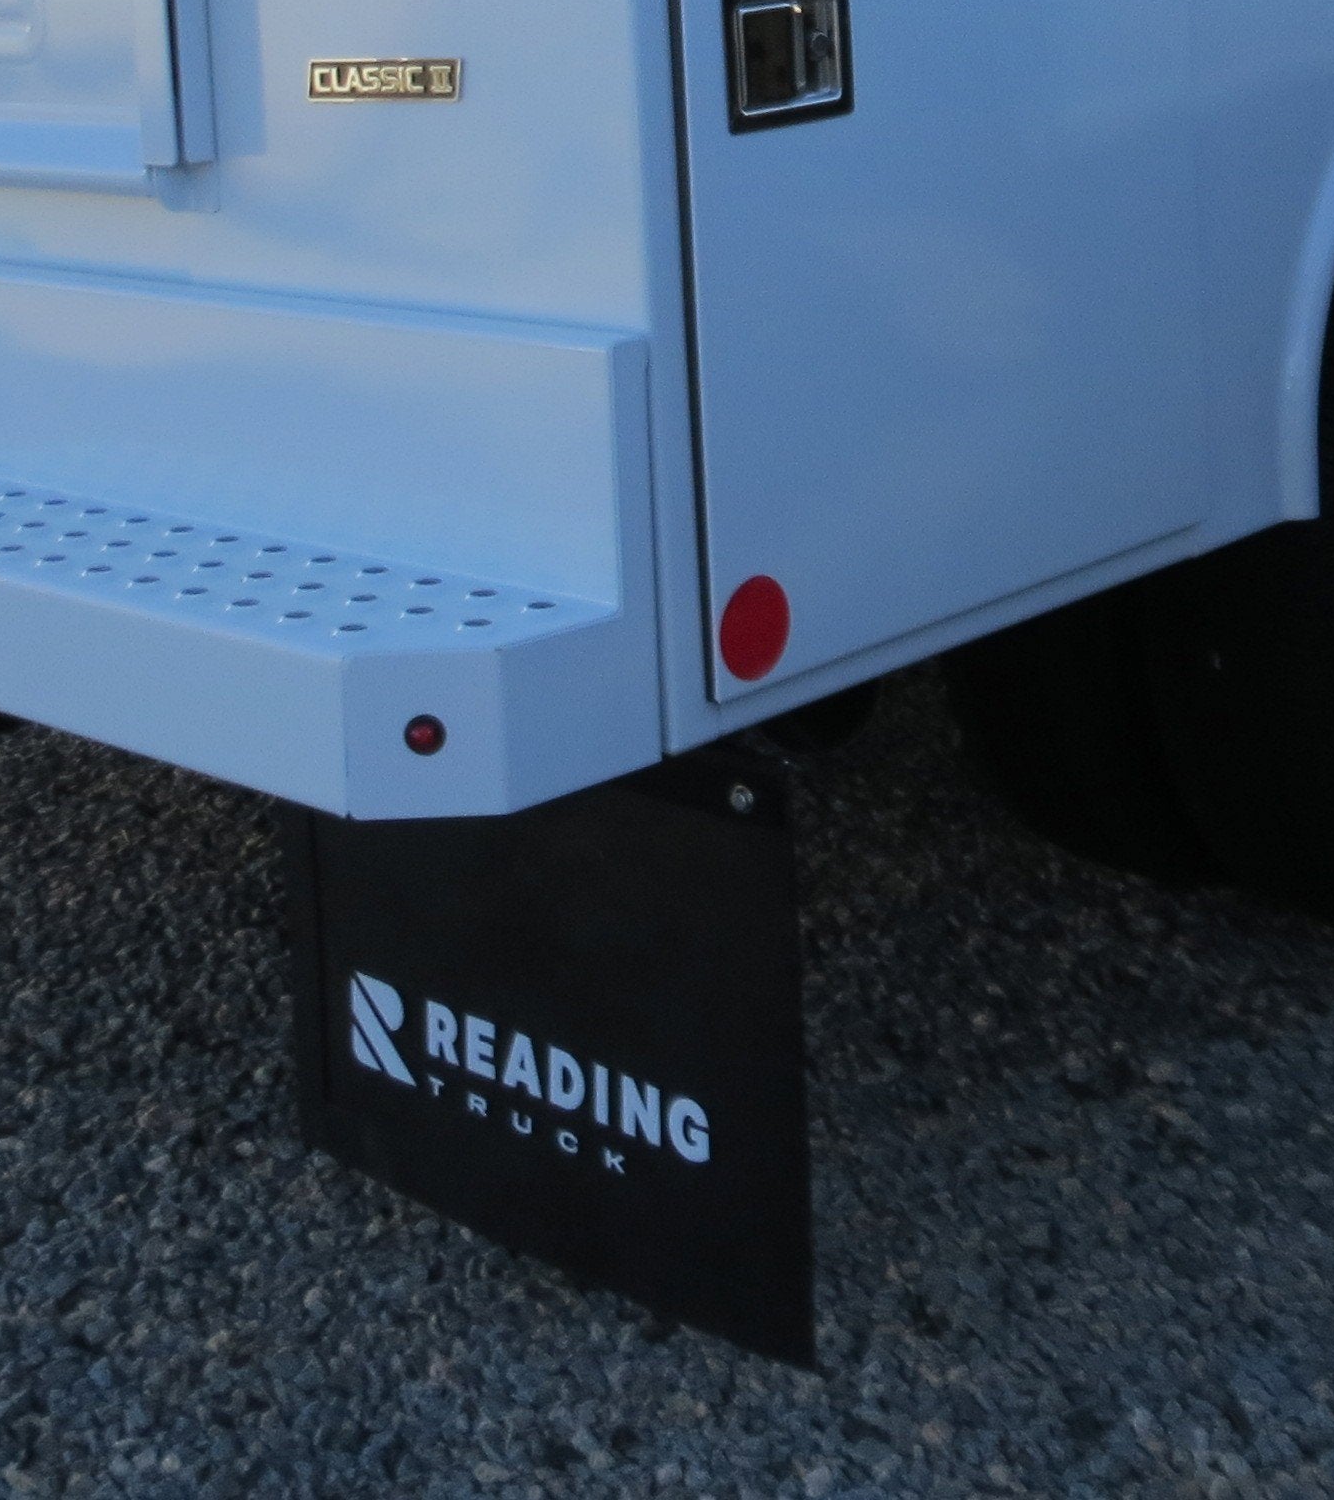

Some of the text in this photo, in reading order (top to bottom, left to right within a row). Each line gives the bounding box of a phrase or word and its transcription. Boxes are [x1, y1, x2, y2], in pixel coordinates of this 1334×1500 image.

[313, 66, 454, 94] CLASSIC II
[425, 999, 710, 1163] READING
[427, 1075, 626, 1175] TRUCK
